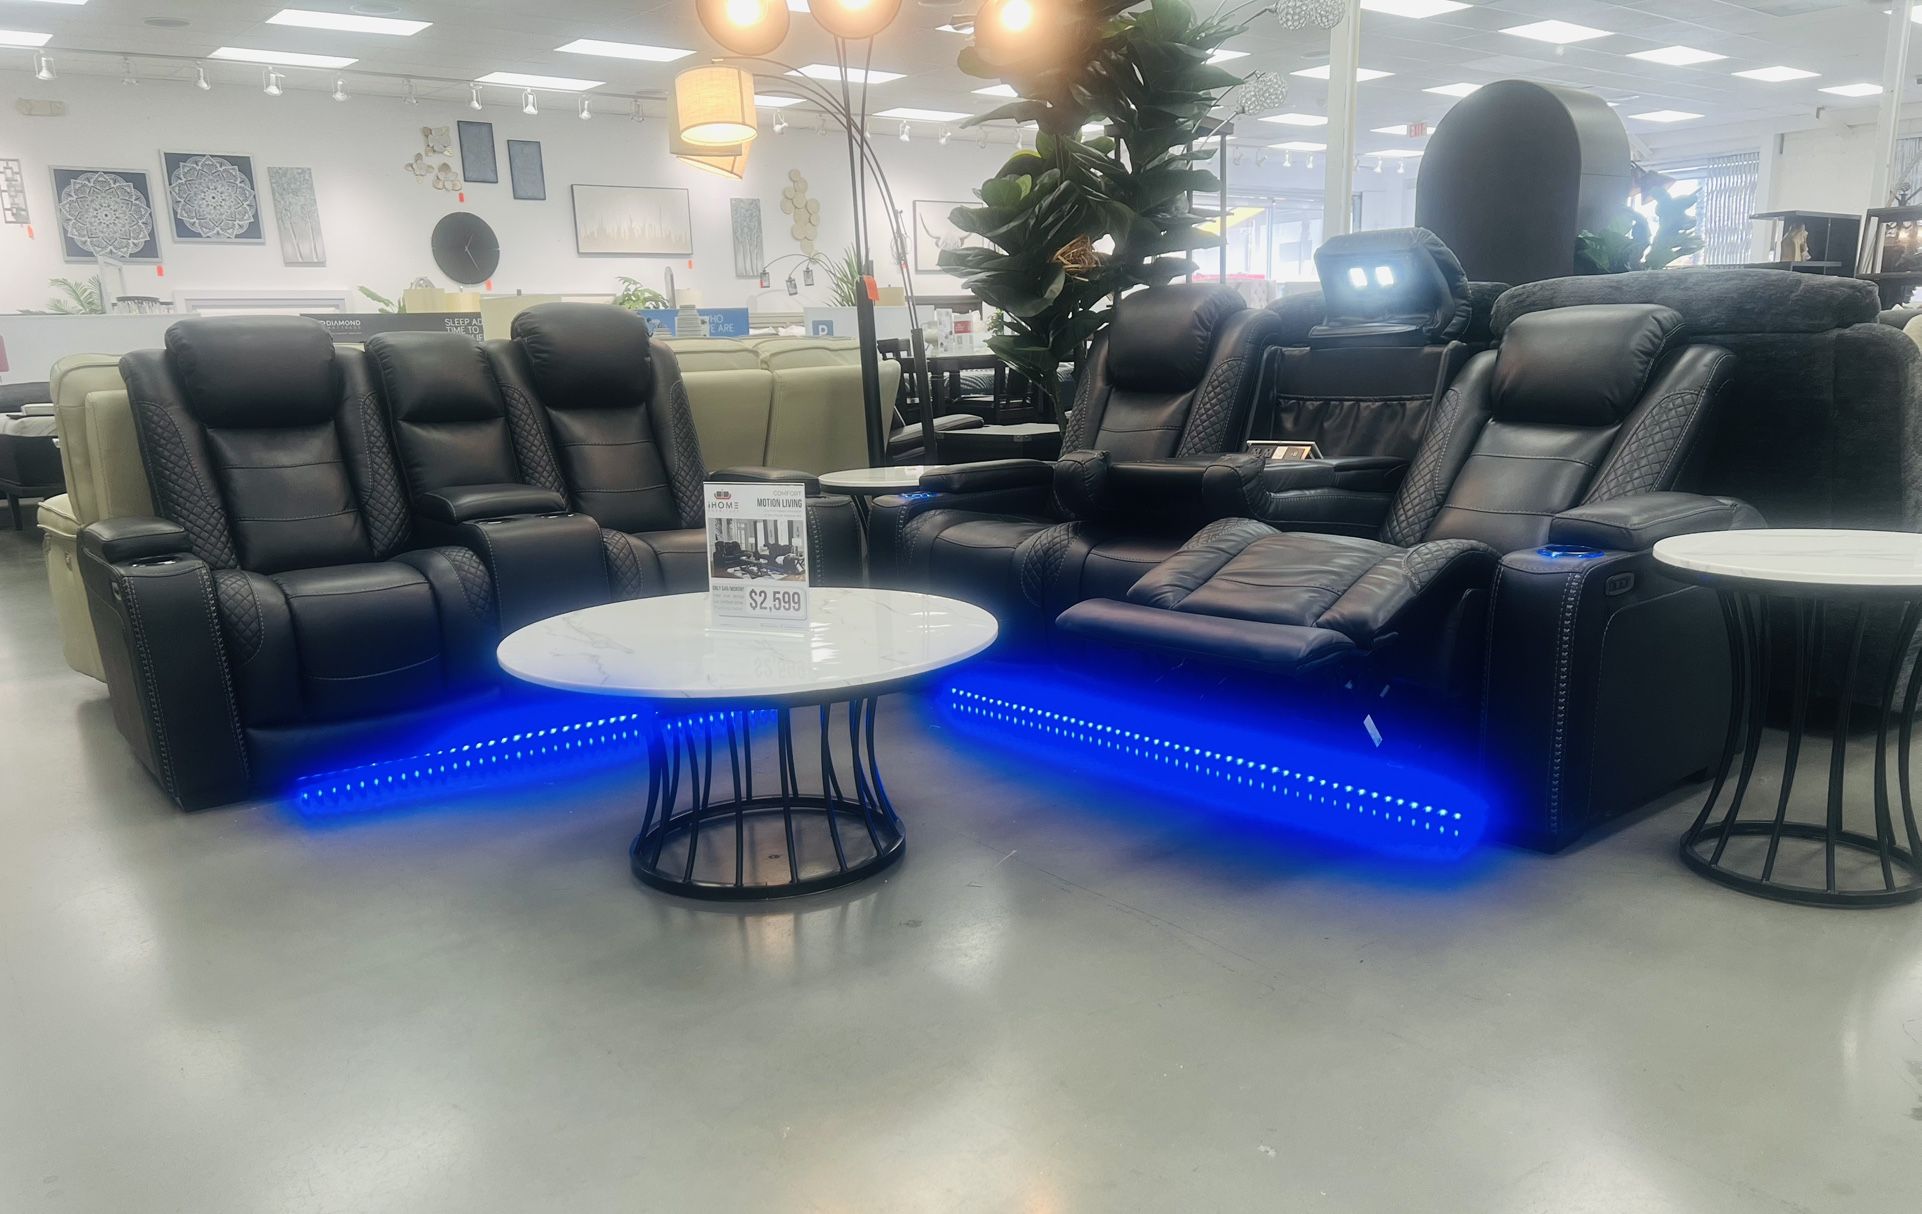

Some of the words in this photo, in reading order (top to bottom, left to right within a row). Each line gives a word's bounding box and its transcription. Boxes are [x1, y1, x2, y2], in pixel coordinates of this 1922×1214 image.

[444, 318, 470, 326] SLEEP
[446, 326, 466, 335] TIME
[468, 326, 480, 334] TO
[718, 323, 735, 332] ARE
[757, 498, 781, 508] MOTION
[782, 499, 803, 508] LIVING
[749, 589, 801, 612] $2,599
